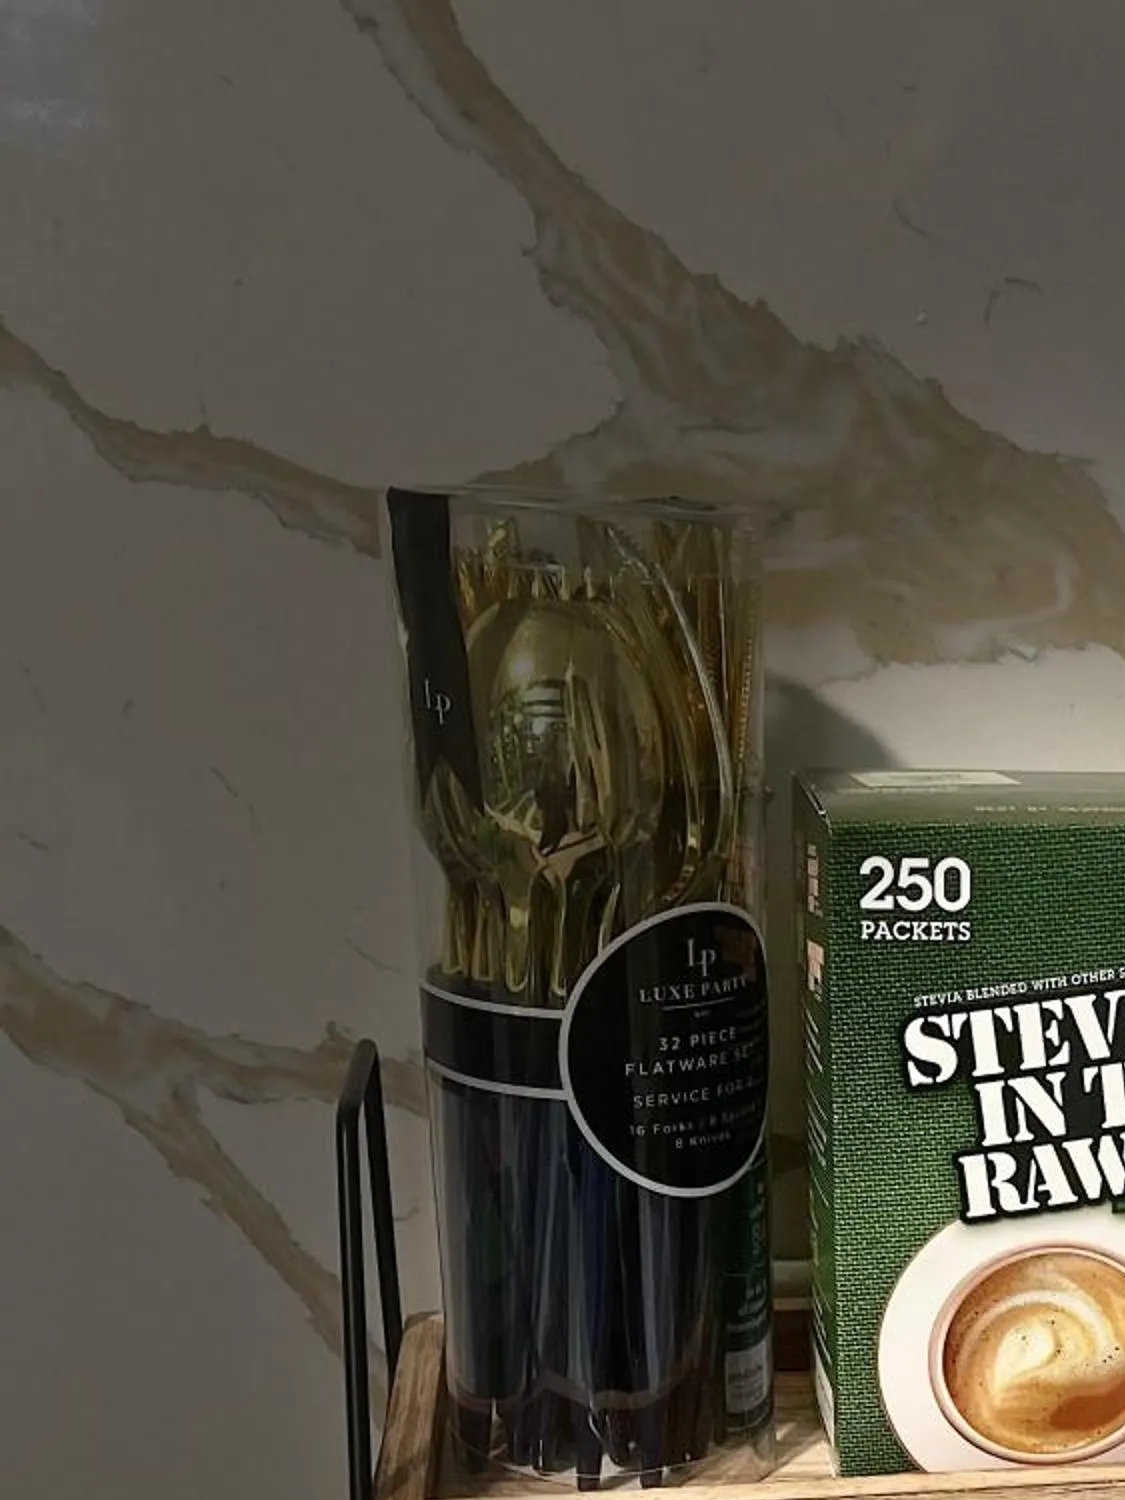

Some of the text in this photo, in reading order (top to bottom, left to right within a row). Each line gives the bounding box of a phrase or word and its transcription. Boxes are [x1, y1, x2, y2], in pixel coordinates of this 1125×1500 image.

[859, 855, 972, 912] 250
[860, 920, 972, 942] PACKETS
[638, 982, 696, 1003] LUXE
[913, 990, 963, 1009] STEVIA
[965, 980, 1028, 1001] BLENDED
[1030, 975, 1068, 992] WITH
[1071, 968, 1116, 986] OTHER
[657, 1025, 738, 1052] 32 PIECE
[624, 1050, 730, 1077] FLATWARE
[632, 1086, 711, 1110] SERVICE
[973, 1070, 1069, 1148] IN
